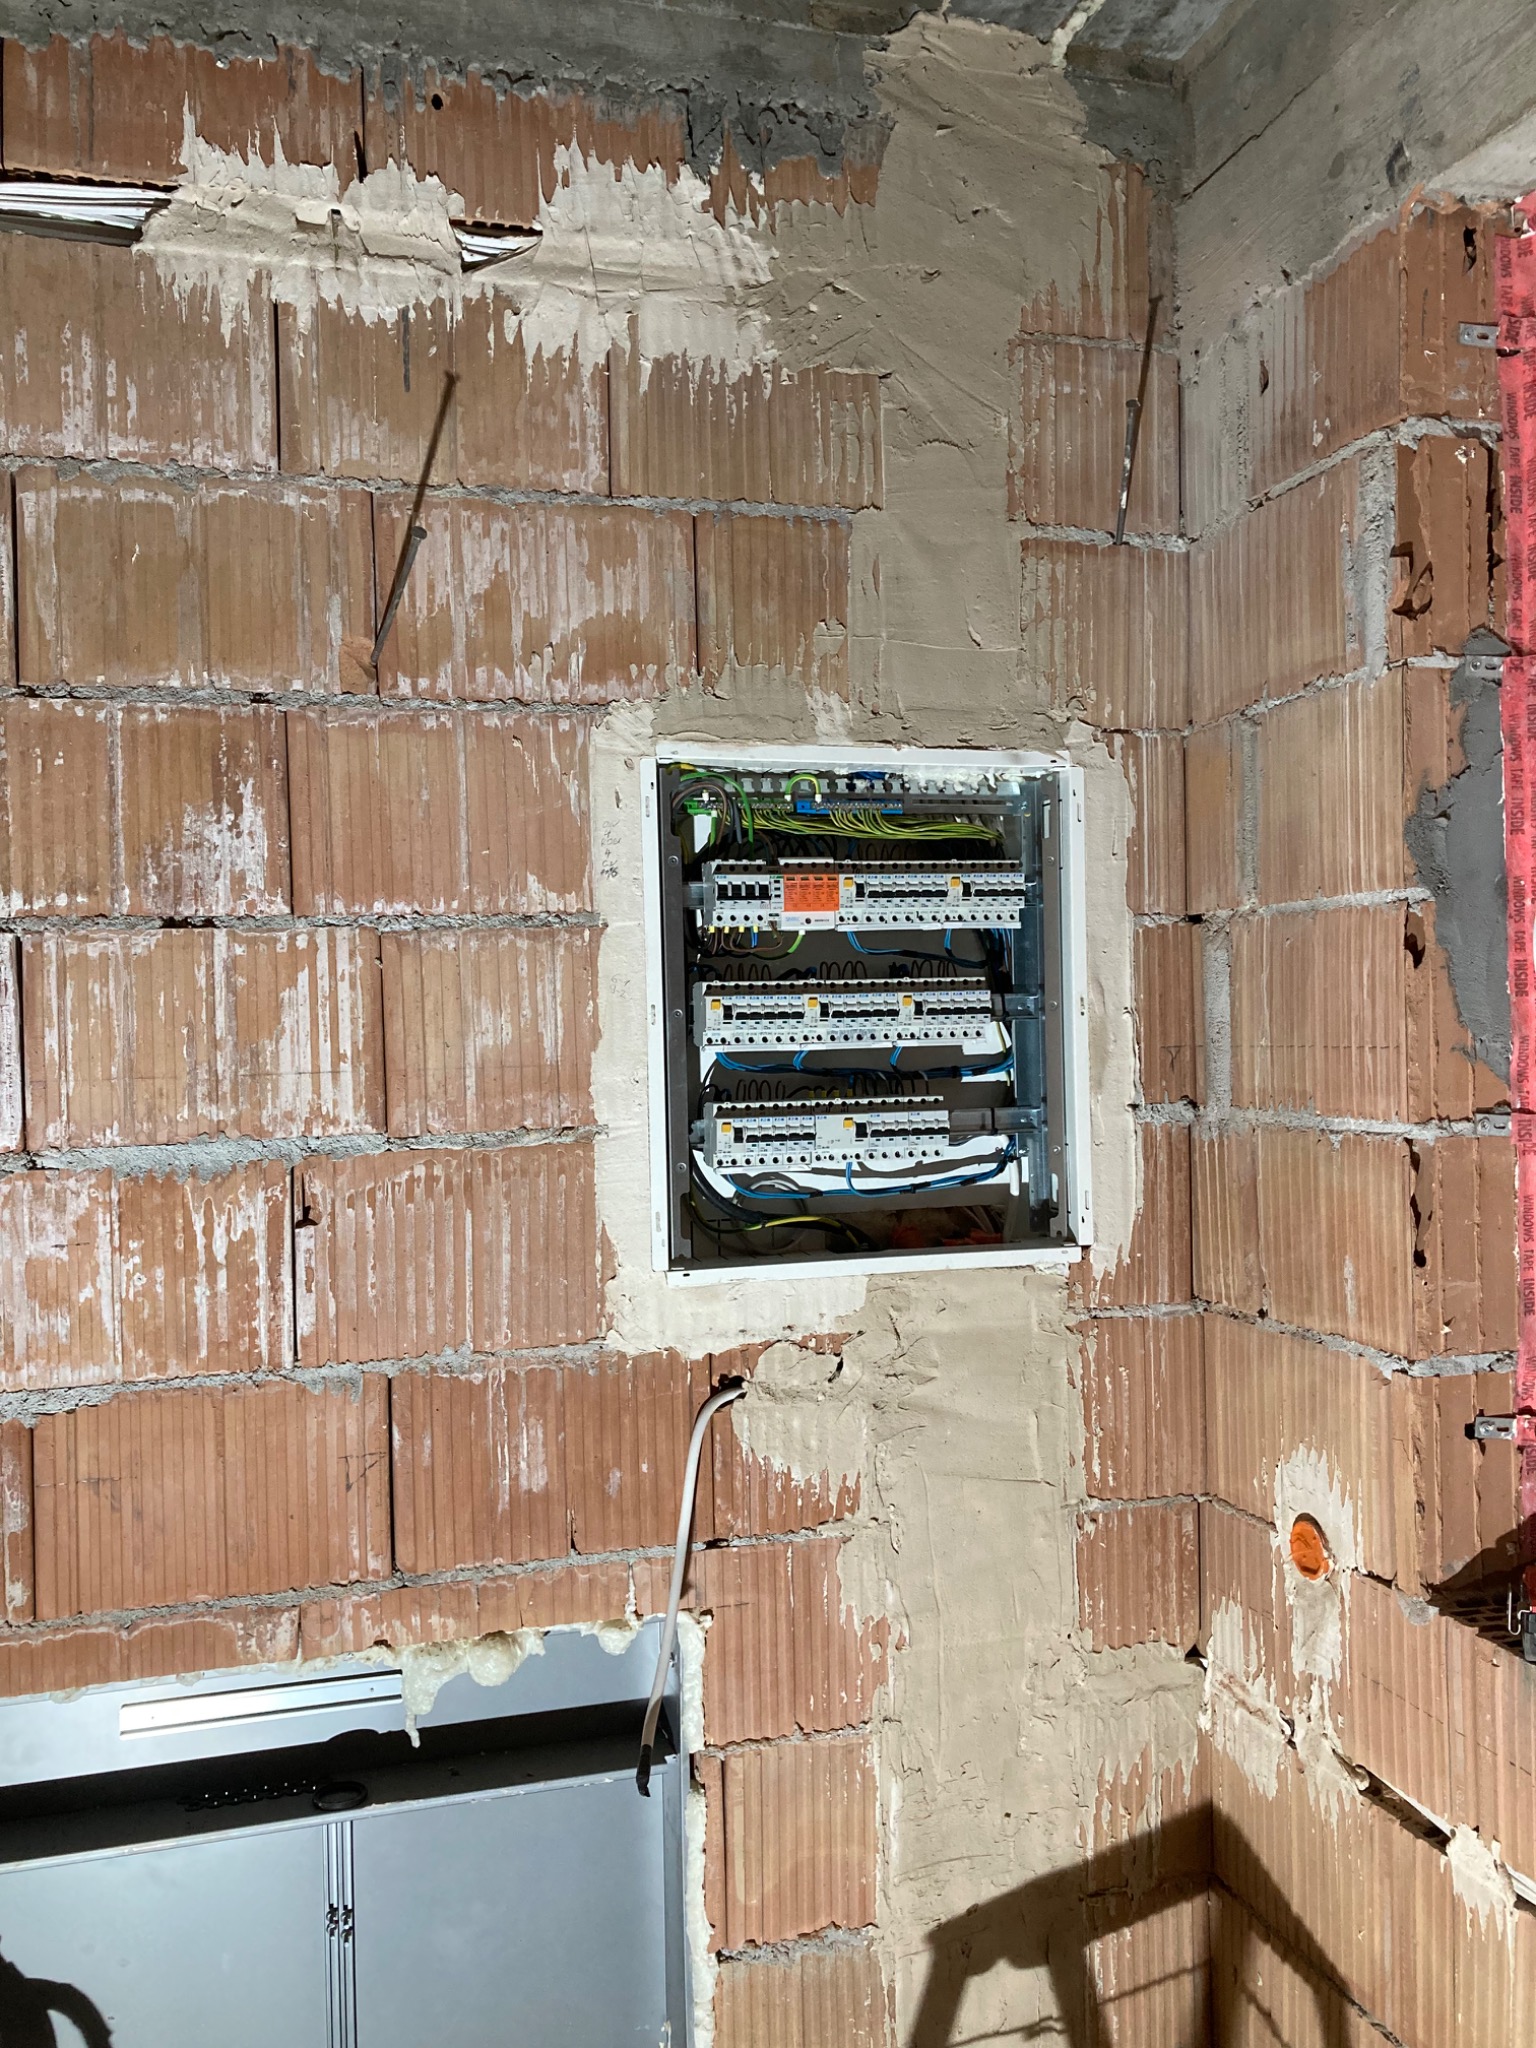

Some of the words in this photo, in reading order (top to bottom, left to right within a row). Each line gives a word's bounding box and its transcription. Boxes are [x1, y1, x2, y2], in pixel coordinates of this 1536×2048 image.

[1501, 285, 1513, 308] TAPE
[1506, 392, 1519, 440] WINDOWS
[1510, 447, 1520, 469] TAPE
[1510, 474, 1523, 514] INSIDE
[1511, 554, 1522, 600] WINDOWS
[1512, 608, 1523, 631] TAPE
[1509, 713, 1521, 761] WINDOWS
[1510, 768, 1523, 791] TAPE
[1510, 797, 1525, 835] INSIDE
[1513, 875, 1525, 923] WINDOWS
[1514, 931, 1526, 953] TAPE
[1515, 959, 1528, 997] INSIDE
[1517, 1035, 1529, 1084] WINDOWS
[1523, 1194, 1534, 1243] WINDOWS
[1523, 1249, 1533, 1271] TAPE
[1523, 1278, 1535, 1317] INSIDE
[1521, 1356, 1536, 1402] WINDOWS
